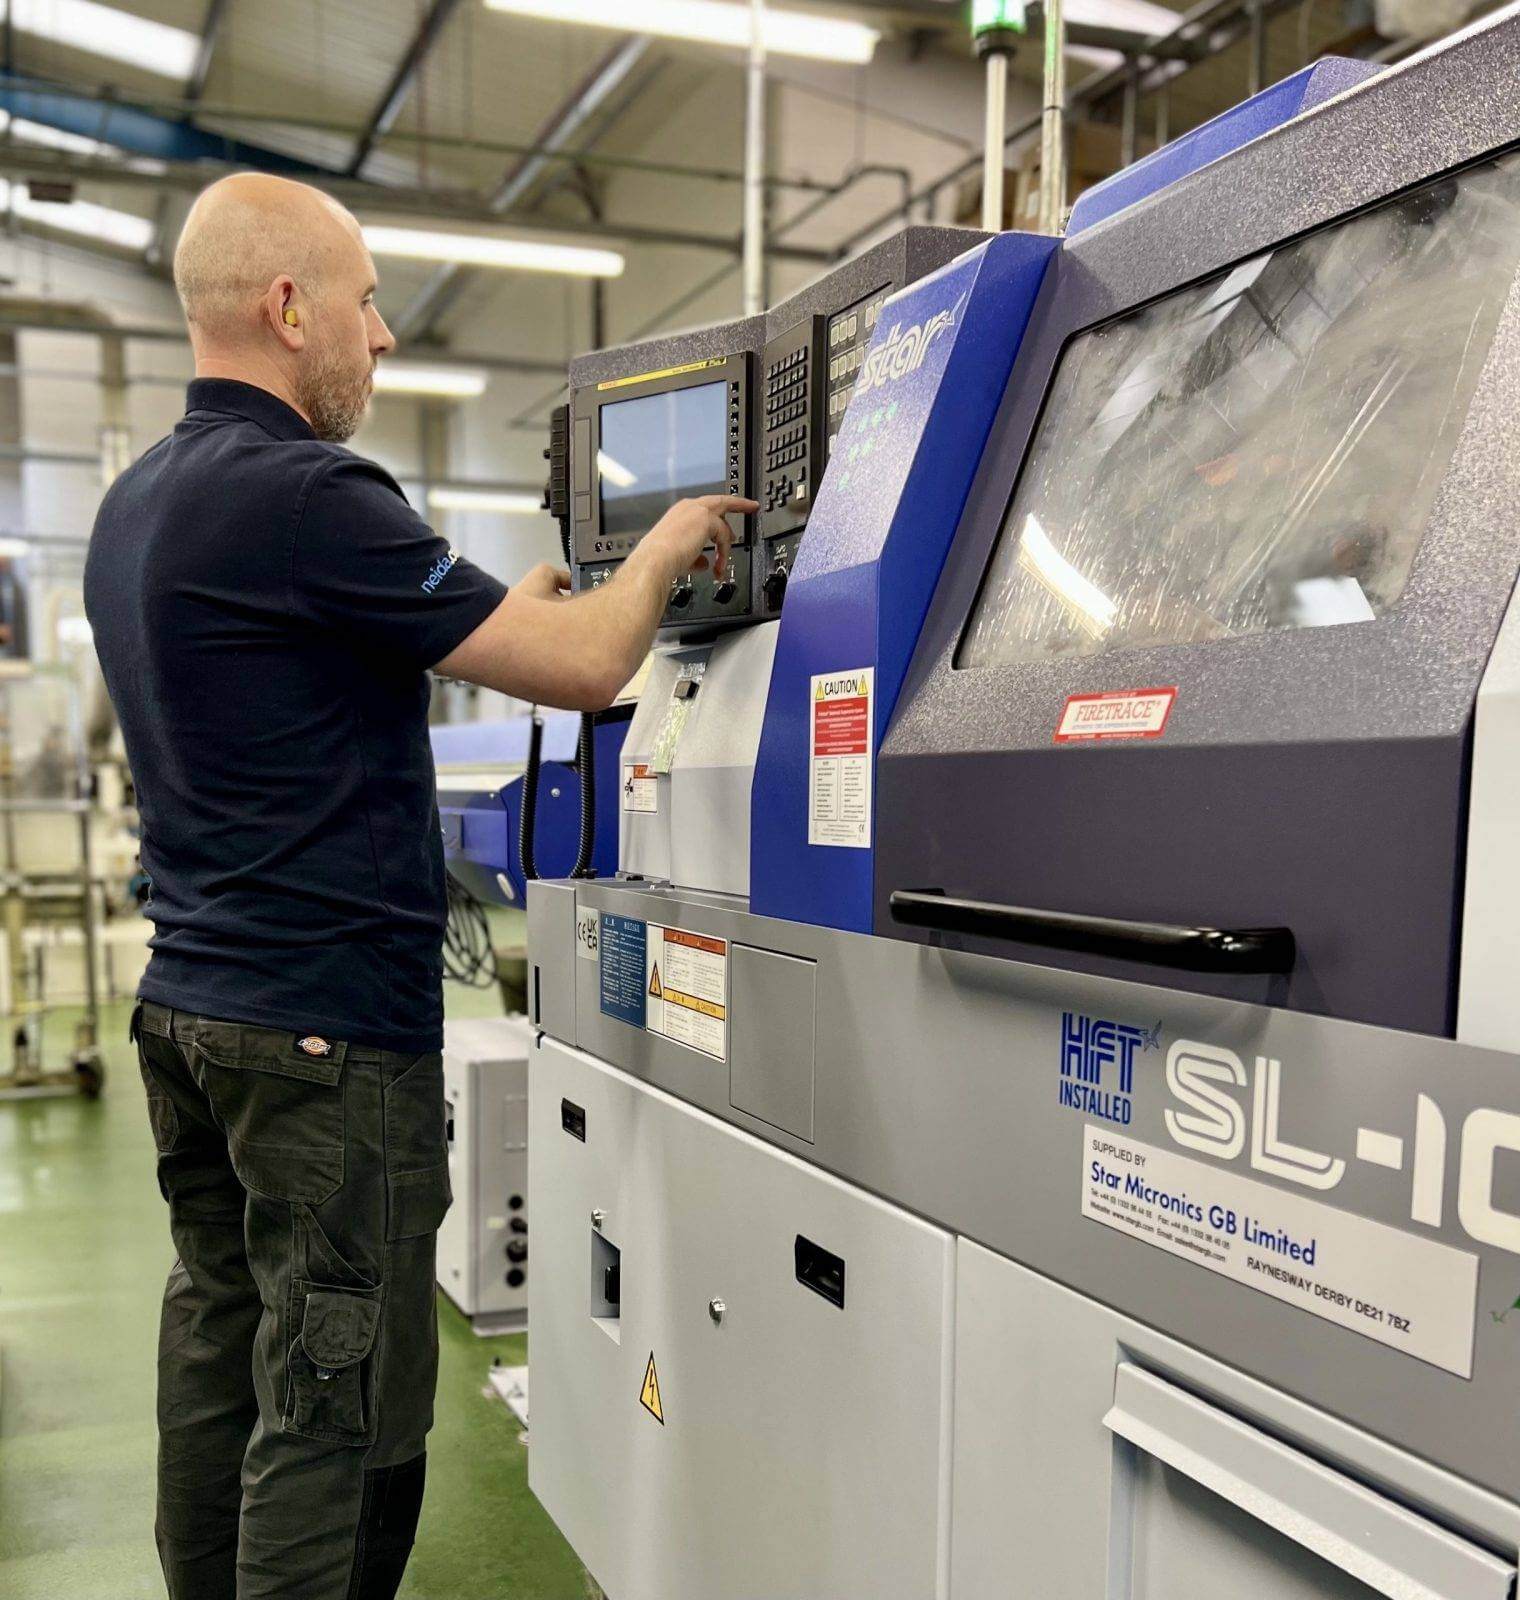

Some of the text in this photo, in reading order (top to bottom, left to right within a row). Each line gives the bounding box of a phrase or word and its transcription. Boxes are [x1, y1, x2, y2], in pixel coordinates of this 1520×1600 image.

[824, 679, 858, 696] CAUTION
[1059, 1079, 1131, 1125] INSTALLED
[1092, 1139, 1146, 1168] SUPPLIED BY
[1091, 1161, 1316, 1266] Star Micronics GB Limited
[1247, 1256, 1411, 1333] RAYNESWAY DERBY DE21 7BZ
